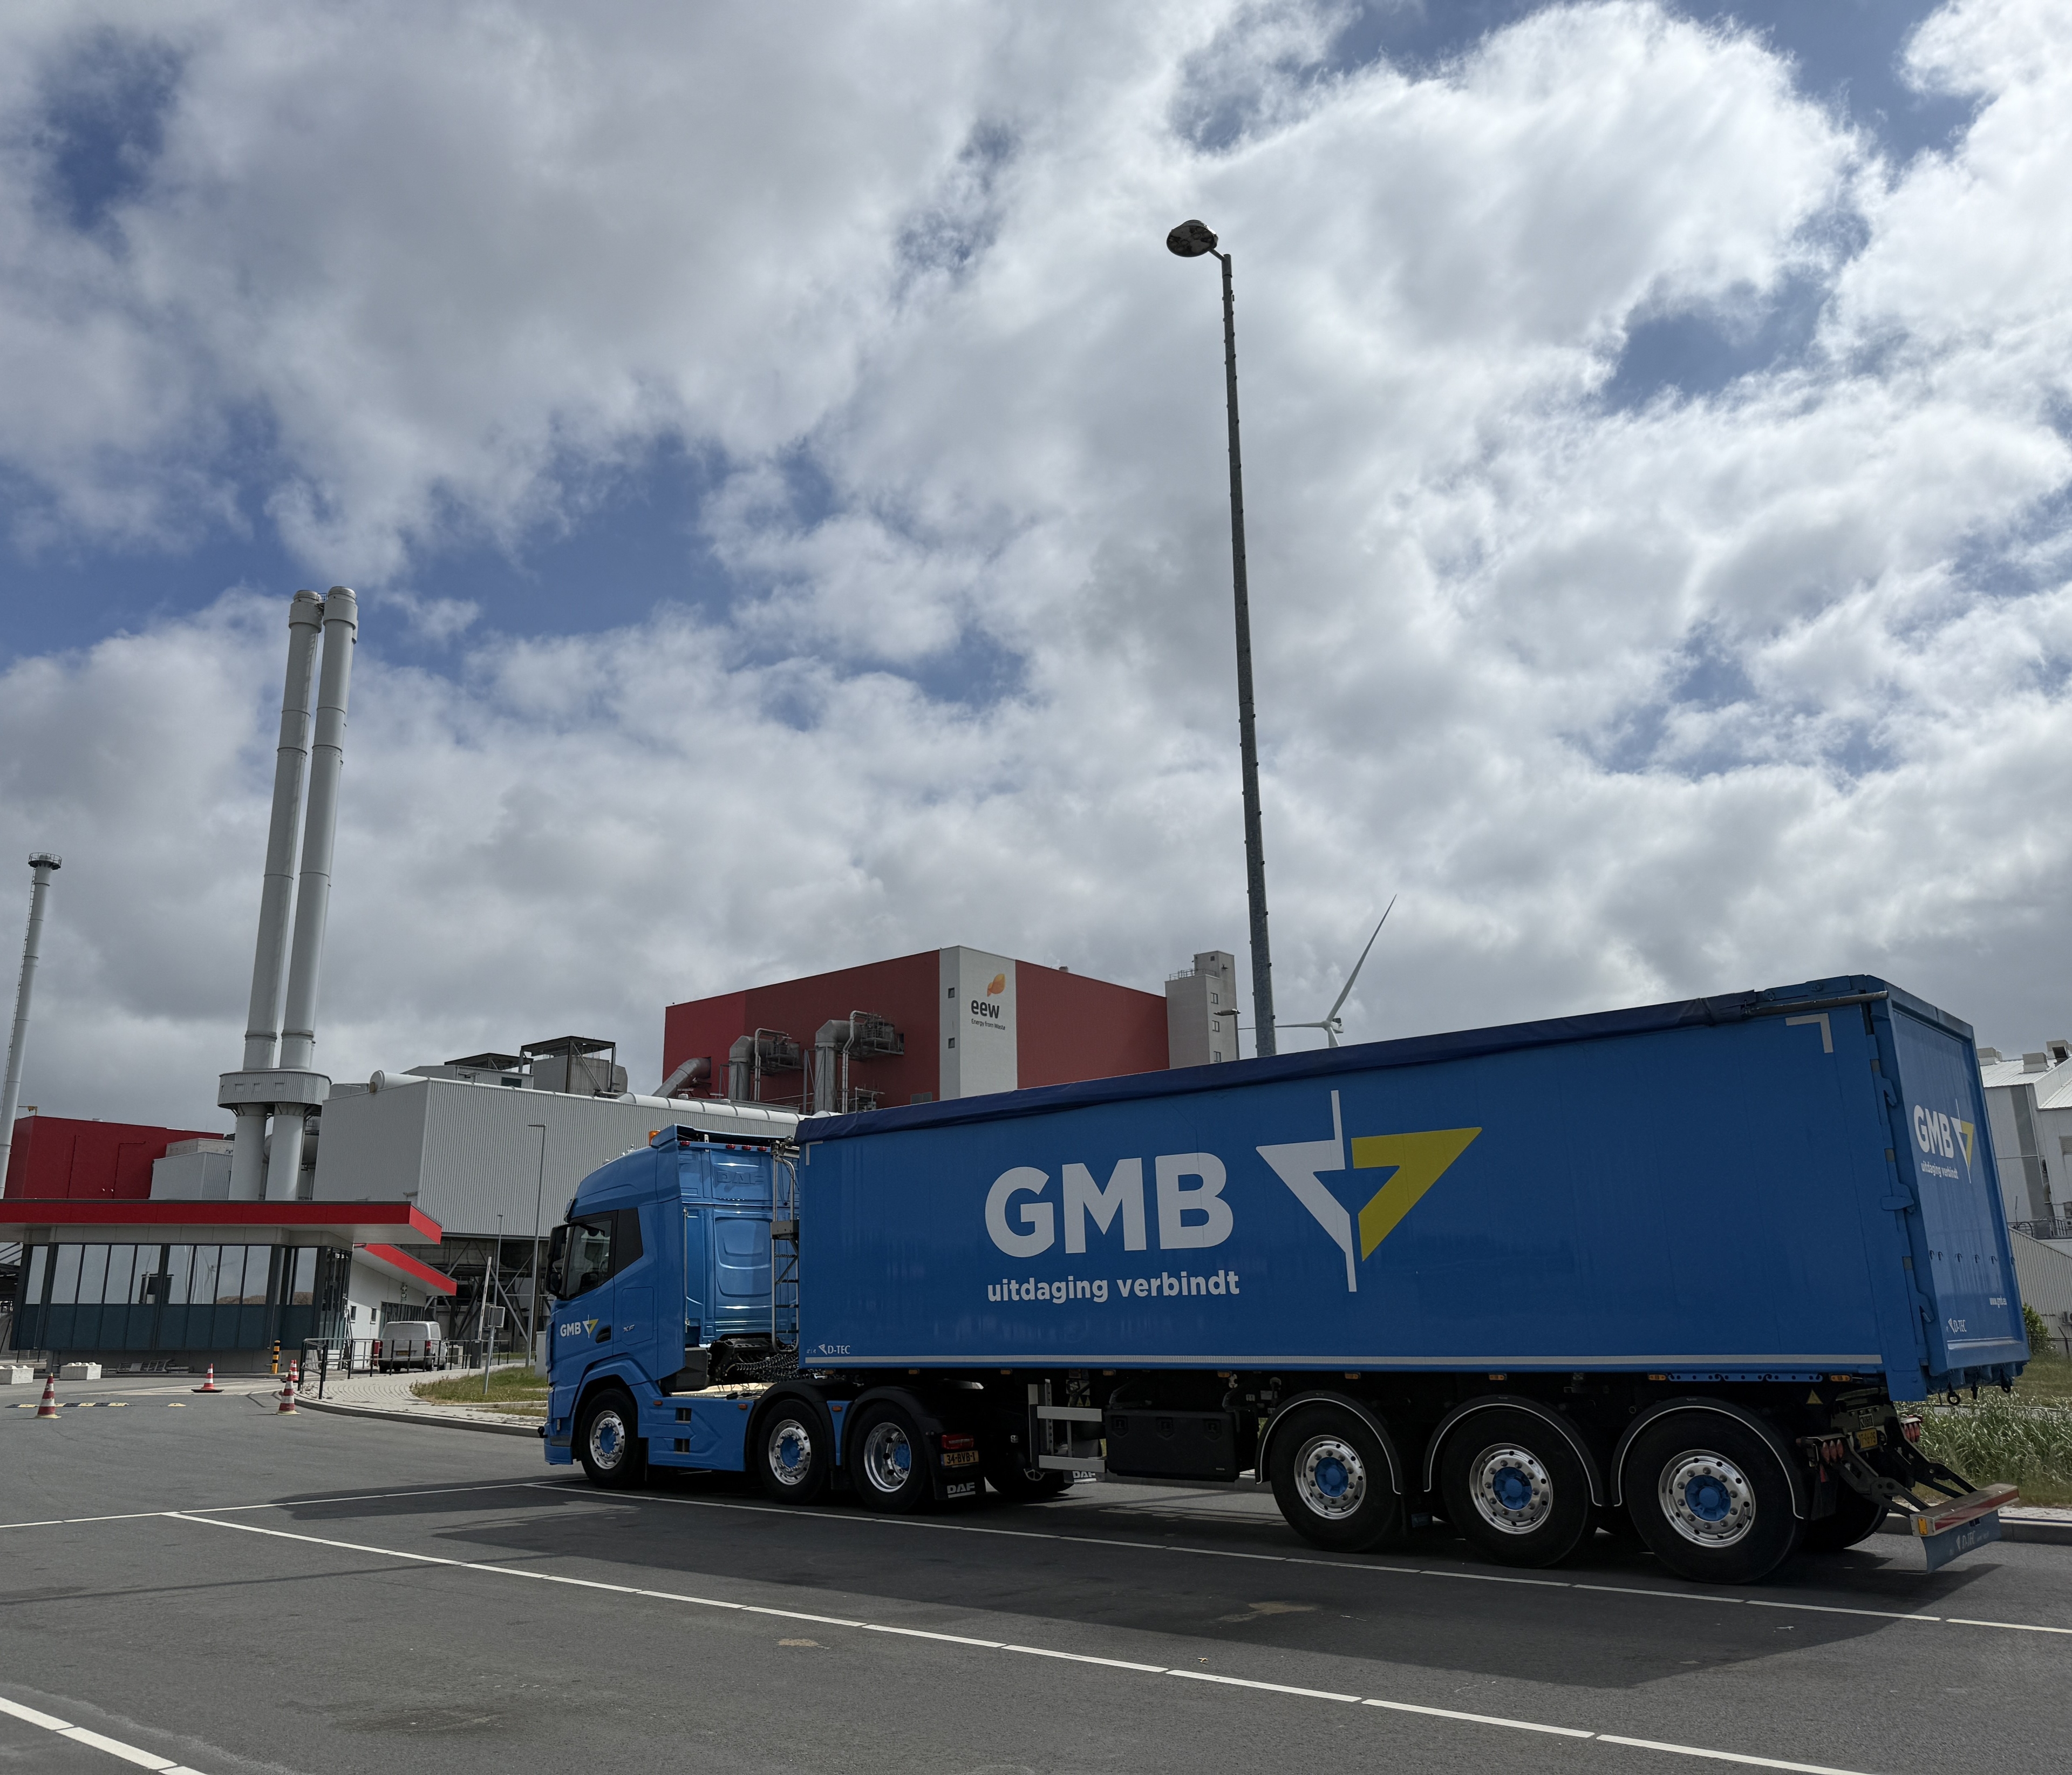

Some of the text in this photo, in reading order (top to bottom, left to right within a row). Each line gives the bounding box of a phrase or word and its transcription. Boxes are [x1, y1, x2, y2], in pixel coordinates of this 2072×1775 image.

[971, 999, 1000, 1019] eew
[971, 1018, 984, 1028] Energy
[994, 1022, 1006, 1031] Waste
[1913, 1104, 1954, 1159] GMB
[1920, 1160, 1959, 1180] uitdaging verbindt
[717, 1171, 764, 1185] DAF
[985, 1152, 1234, 1258] GMB
[987, 1270, 1240, 1304] uitdaging verbindt
[560, 1322, 582, 1337] GMB
[1953, 1319, 1967, 1333] D-TEC
[827, 1345, 851, 1355] D-TEC
[946, 1452, 976, 1464] 34-BVB-1
[946, 1481, 976, 1494] DAF
